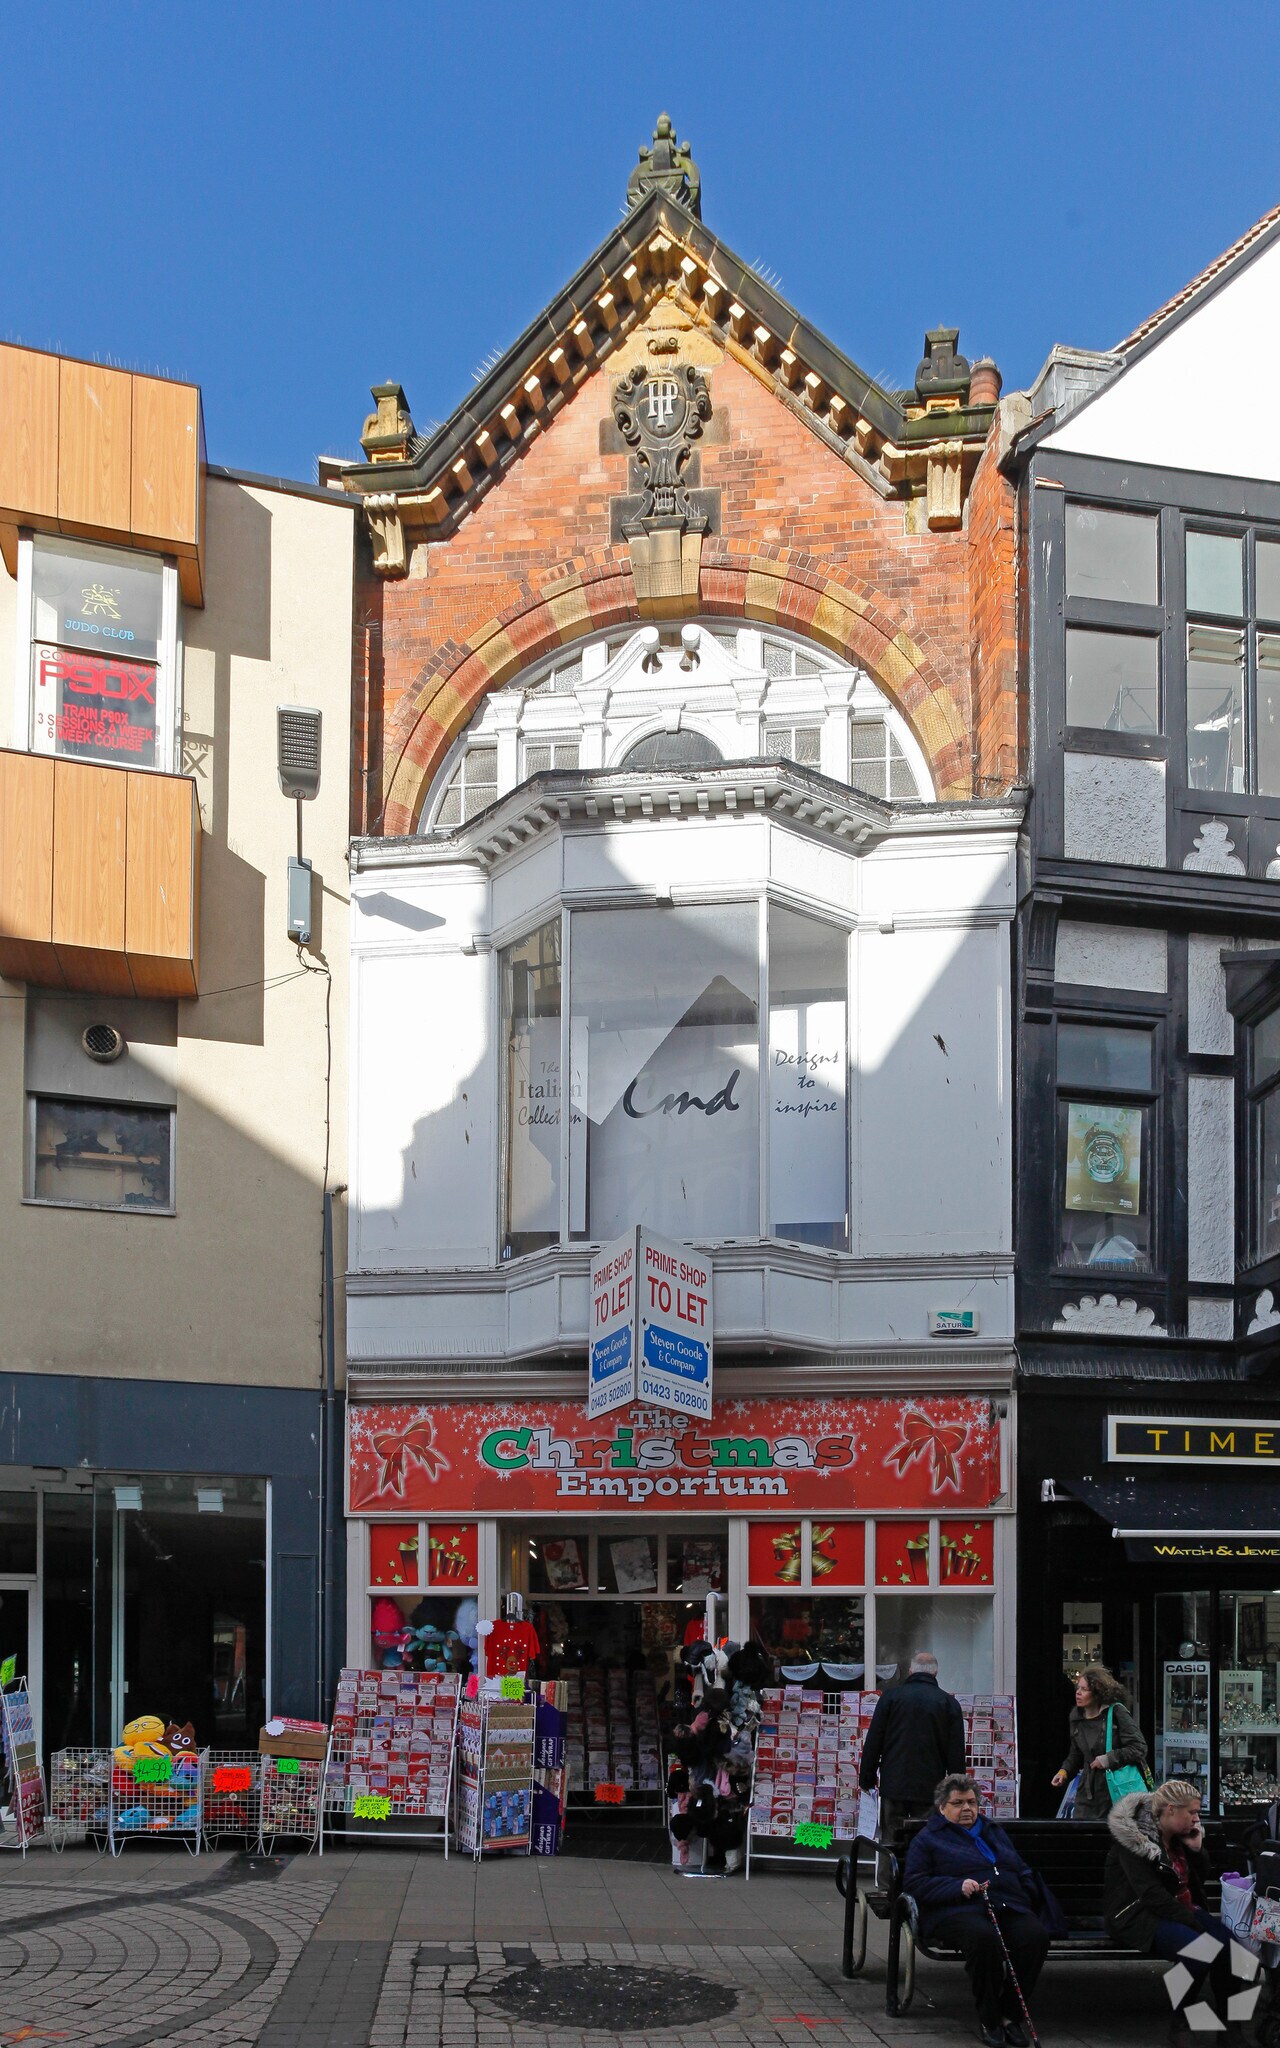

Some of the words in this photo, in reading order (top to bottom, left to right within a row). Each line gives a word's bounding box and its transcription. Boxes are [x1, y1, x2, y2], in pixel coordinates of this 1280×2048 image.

[65, 619, 99, 634] JUDO
[102, 627, 135, 640] CLUB
[40, 650, 105, 668] COMING
[40, 659, 155, 704] P90X
[63, 703, 98, 720] TRAIN
[100, 709, 128, 724] P90X
[38, 713, 44, 724] 3
[47, 714, 105, 734] SESSIONS
[108, 723, 117, 734] A
[119, 724, 153, 741] WEEK
[48, 727, 54, 739] 6
[57, 728, 92, 745] WEEK
[94, 733, 143, 752] COURSE
[541, 1061, 560, 1074] The
[775, 1049, 839, 1075] Designs
[518, 1078, 582, 1099] Italin
[798, 1075, 815, 1089] to
[775, 1100, 838, 1118] inspire
[594, 1263, 613, 1292] PRIME
[613, 1248, 632, 1277] SHOP
[645, 1247, 678, 1278] PRIME
[680, 1262, 707, 1288] SHOP
[594, 1292, 609, 1327] TO
[611, 1274, 633, 1317] LET
[647, 1275, 671, 1313] TO
[677, 1288, 708, 1327] LET
[595, 1346, 610, 1361] Steven
[610, 1332, 628, 1352] Goode
[650, 1330, 675, 1351] Steven
[676, 1341, 703, 1361] Goode
[603, 1354, 622, 1371] Company
[658, 1350, 664, 1362] &
[664, 1352, 696, 1375] Company
[591, 1392, 607, 1411] 01423
[608, 1380, 632, 1403] 502800
[642, 1380, 671, 1400] 01423
[674, 1390, 708, 1411] 502800
[629, 1408, 689, 1429] The
[481, 1427, 854, 1470] Christmas
[1146, 1429, 1274, 1454] TIME
[556, 1470, 789, 1502] Emporium
[1216, 1546, 1234, 1556] &
[1165, 1664, 1206, 1673] CASIO
[537, 1739, 547, 1766] designer
[535, 1826, 545, 1853] designer
